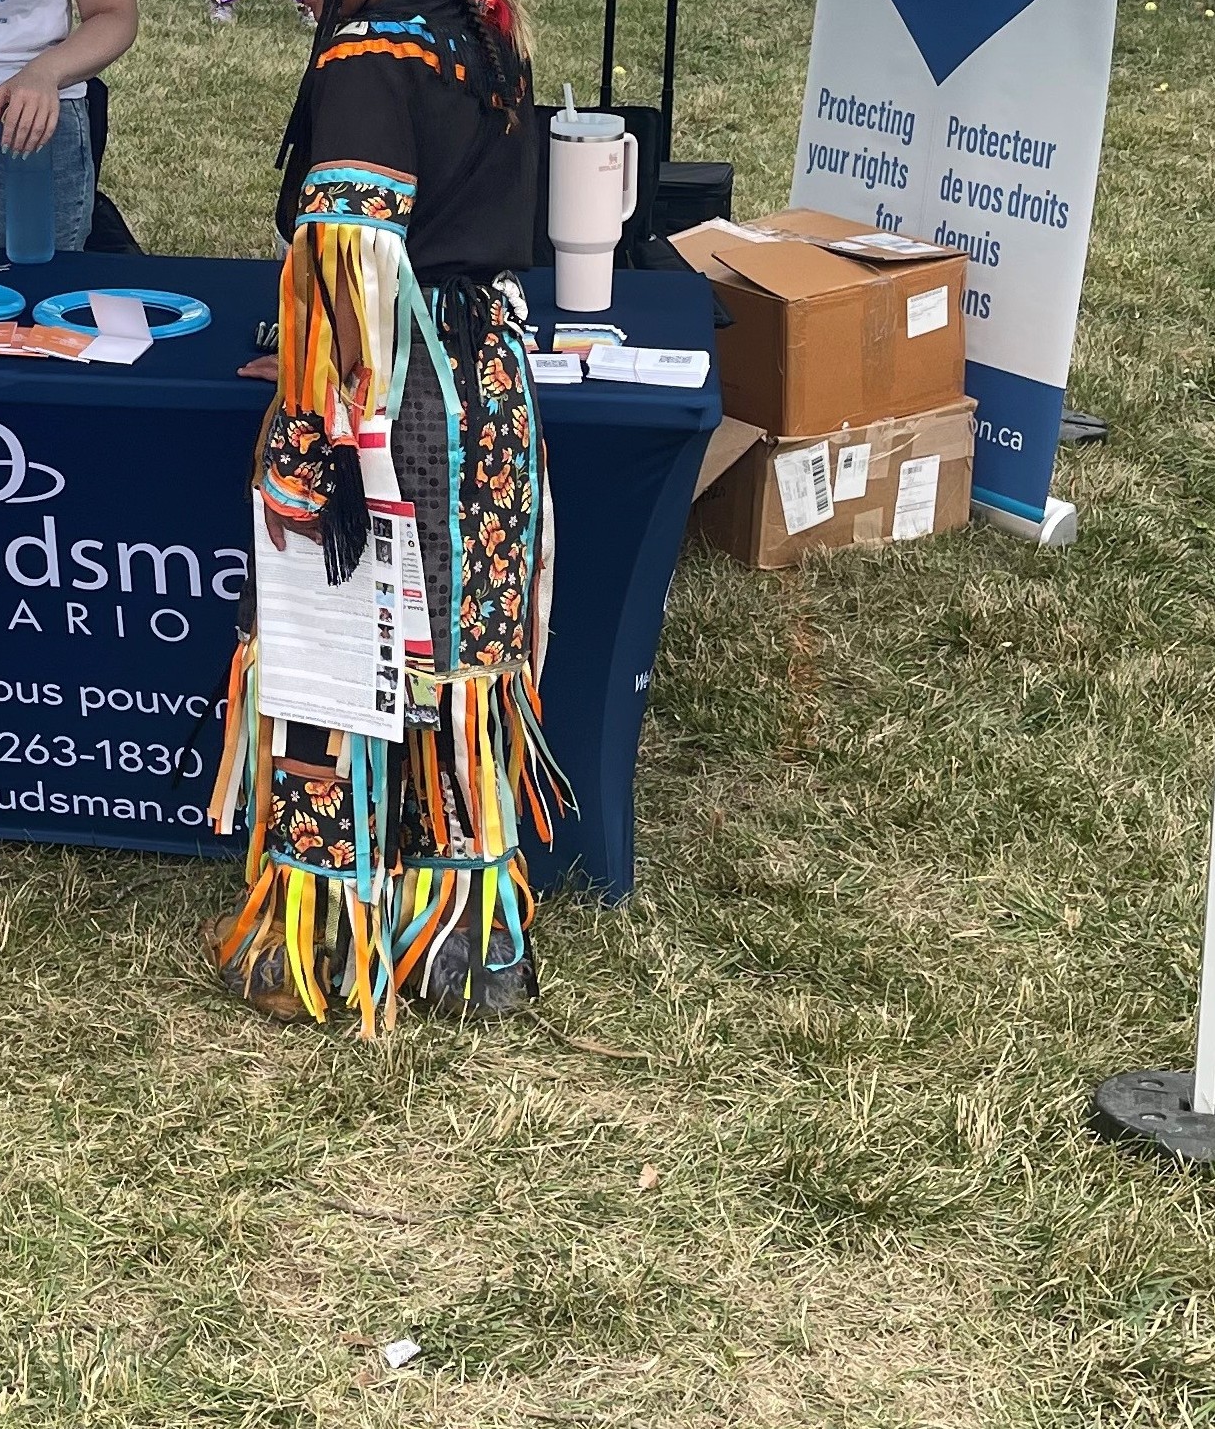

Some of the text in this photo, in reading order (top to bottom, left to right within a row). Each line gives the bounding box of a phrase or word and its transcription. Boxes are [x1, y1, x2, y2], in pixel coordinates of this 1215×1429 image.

[817, 87, 916, 146] Protecting
[806, 142, 909, 189] your rights
[947, 116, 1057, 170] Protecteur
[875, 203, 903, 233] for
[940, 168, 1070, 229] de vos droits
[962, 289, 991, 319] ns
